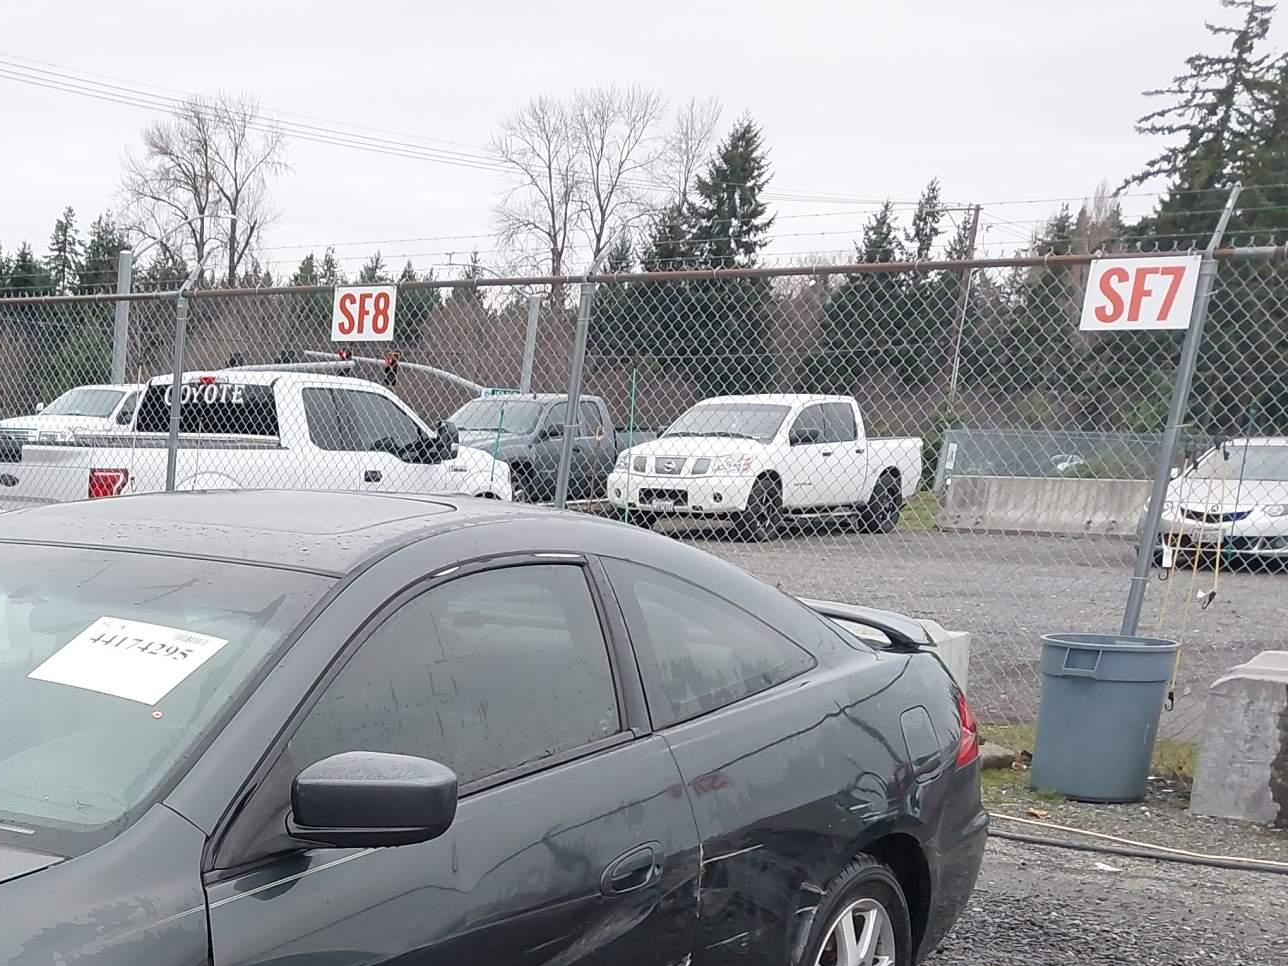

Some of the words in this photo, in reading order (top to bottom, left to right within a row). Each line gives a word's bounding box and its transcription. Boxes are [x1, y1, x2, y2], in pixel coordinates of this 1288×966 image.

[1094, 266, 1187, 323] SF7
[338, 292, 390, 335] SF8
[164, 384, 245, 406] COYOTE
[90, 633, 193, 660] 44174295
